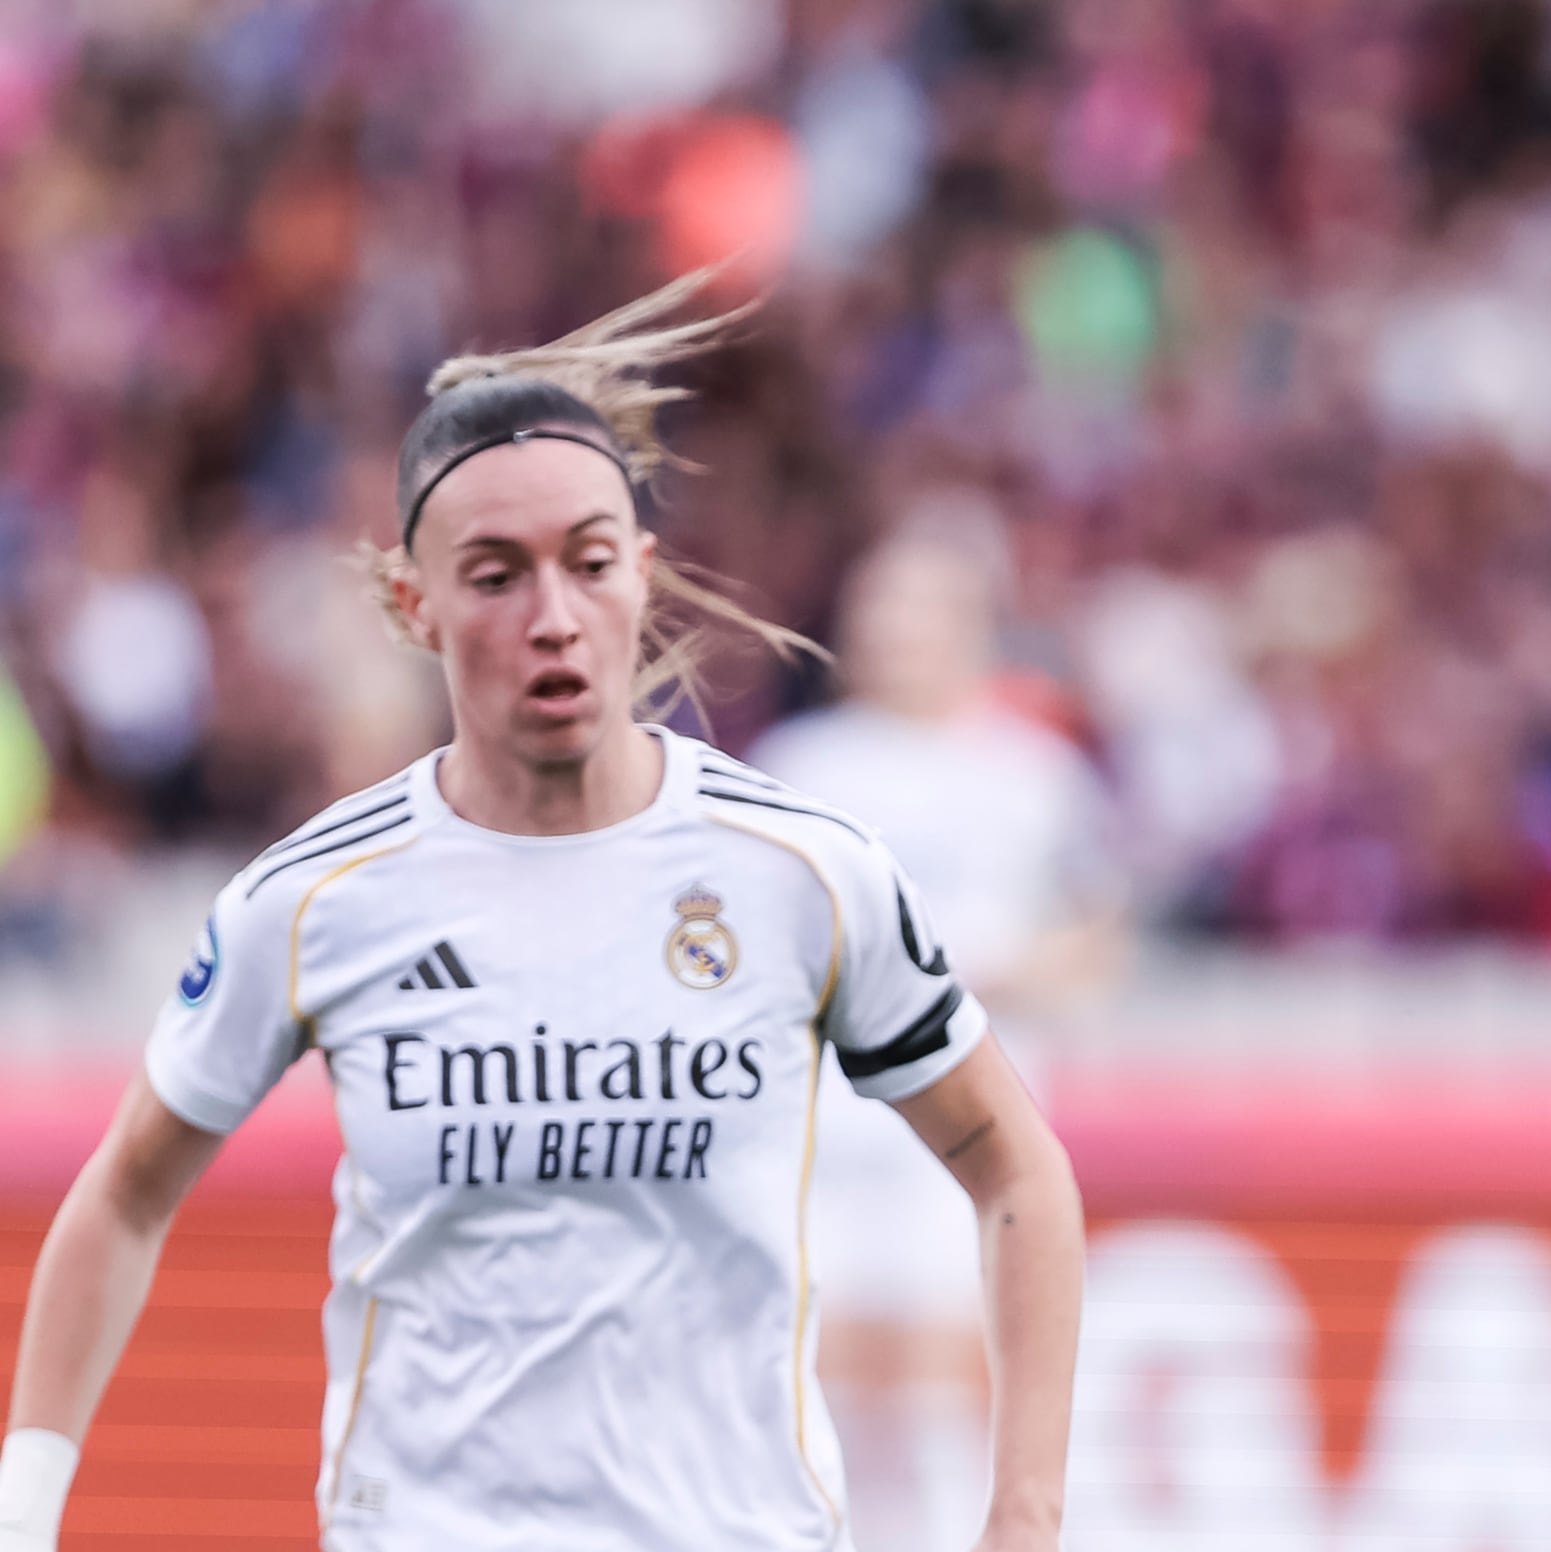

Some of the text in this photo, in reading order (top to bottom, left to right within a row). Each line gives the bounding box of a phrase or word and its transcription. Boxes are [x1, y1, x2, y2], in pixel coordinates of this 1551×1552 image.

[384, 1024, 762, 1111] Emirates
[439, 1118, 713, 1185] FLY BETTER
